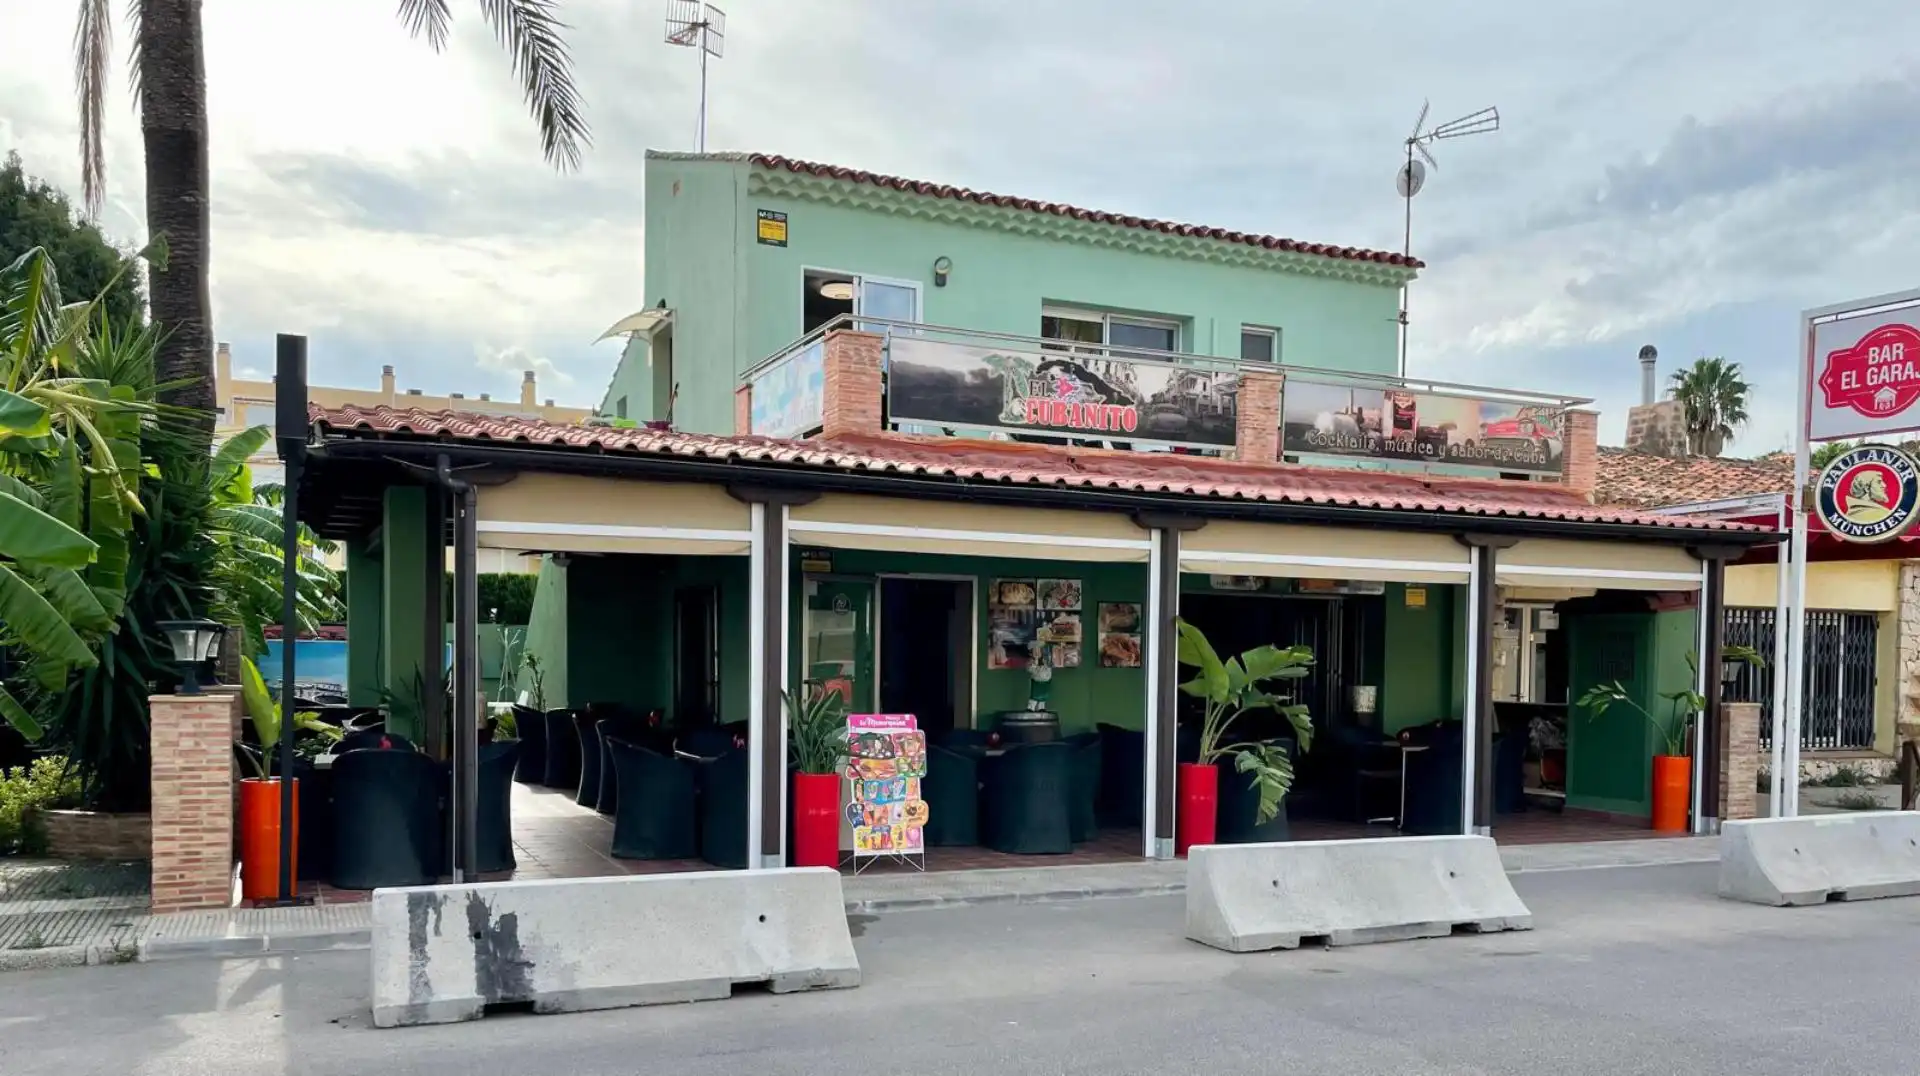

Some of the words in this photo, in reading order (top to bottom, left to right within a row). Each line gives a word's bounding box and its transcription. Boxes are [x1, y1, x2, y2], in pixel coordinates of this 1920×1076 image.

[1868, 342, 1904, 365] BAR
[1029, 379, 1050, 397] EL
[1841, 370, 1861, 390] EL
[1026, 398, 1137, 432] CUBANITO
[1438, 443, 1446, 459] y
[1451, 443, 1490, 460] sabor
[1822, 449, 1915, 489] PAULANER
